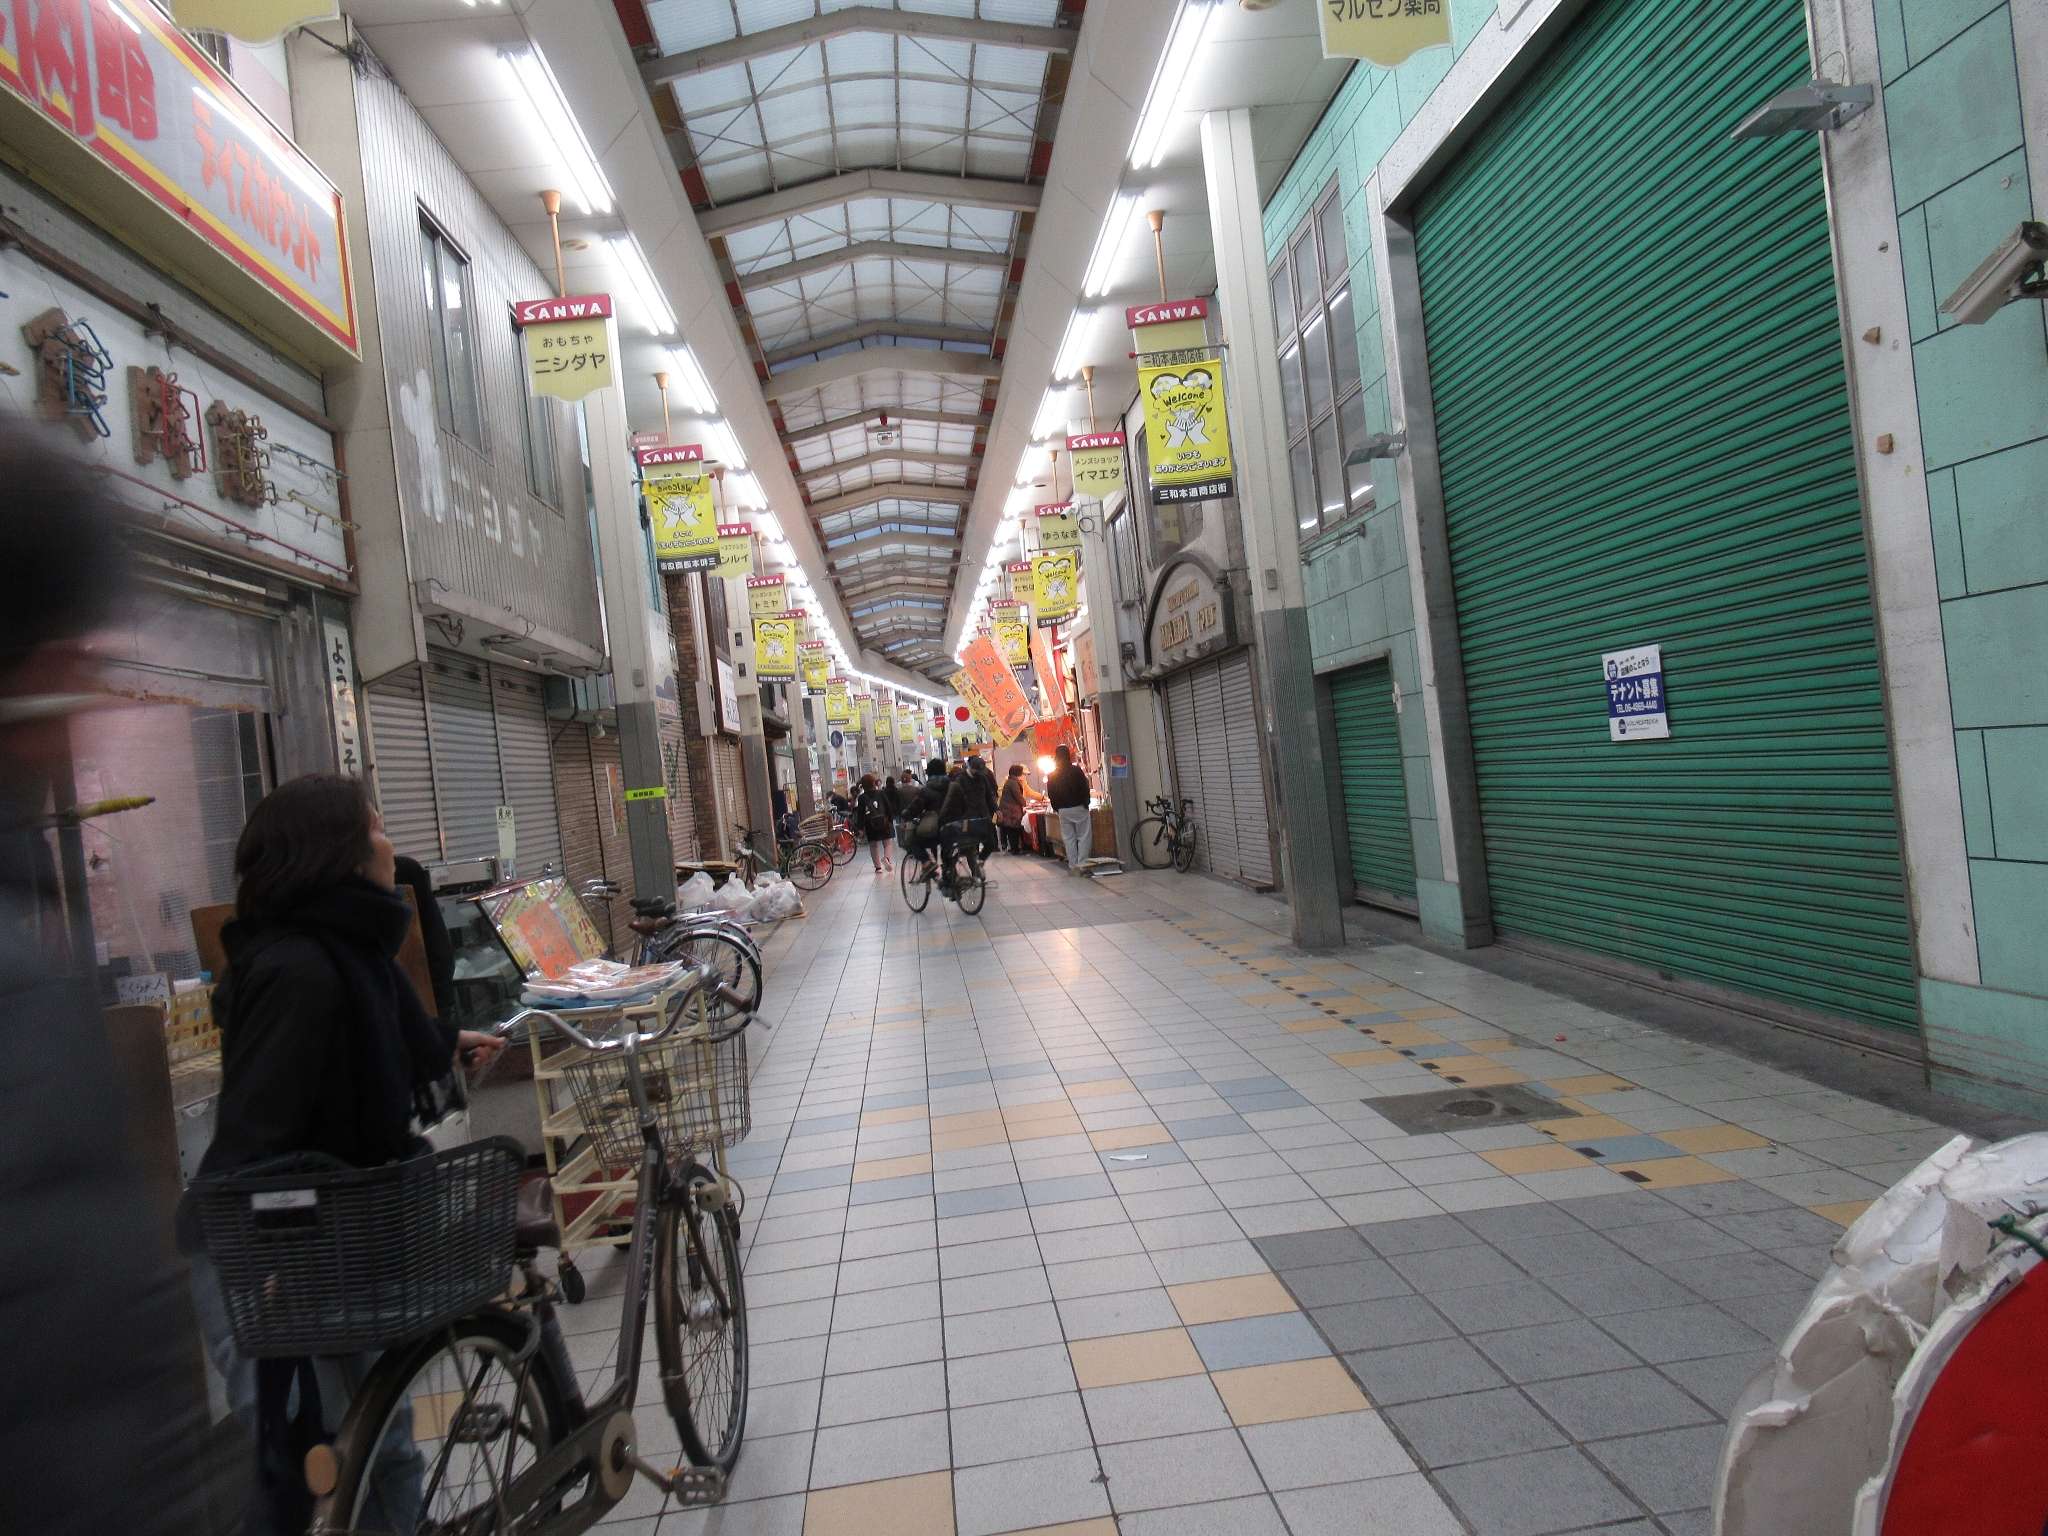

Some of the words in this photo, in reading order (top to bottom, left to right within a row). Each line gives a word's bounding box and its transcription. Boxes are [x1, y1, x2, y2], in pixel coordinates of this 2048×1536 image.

[523, 300, 602, 320] SANWA
[1134, 305, 1201, 324] SANWA
[543, 335, 593, 348] おもちゃ
[535, 352, 606, 374] ニシダヤ
[1071, 435, 1120, 449] SANWA
[643, 449, 698, 464] SANWA
[1177, 450, 1201, 461] いつも
[1155, 457, 1226, 473] ありがとうございます
[1075, 468, 1120, 481] イマエダ
[1160, 482, 1227, 500] 三和本通商店街
[748, 578, 781, 588] SANWA
[1611, 678, 1658, 702] テナント募集
